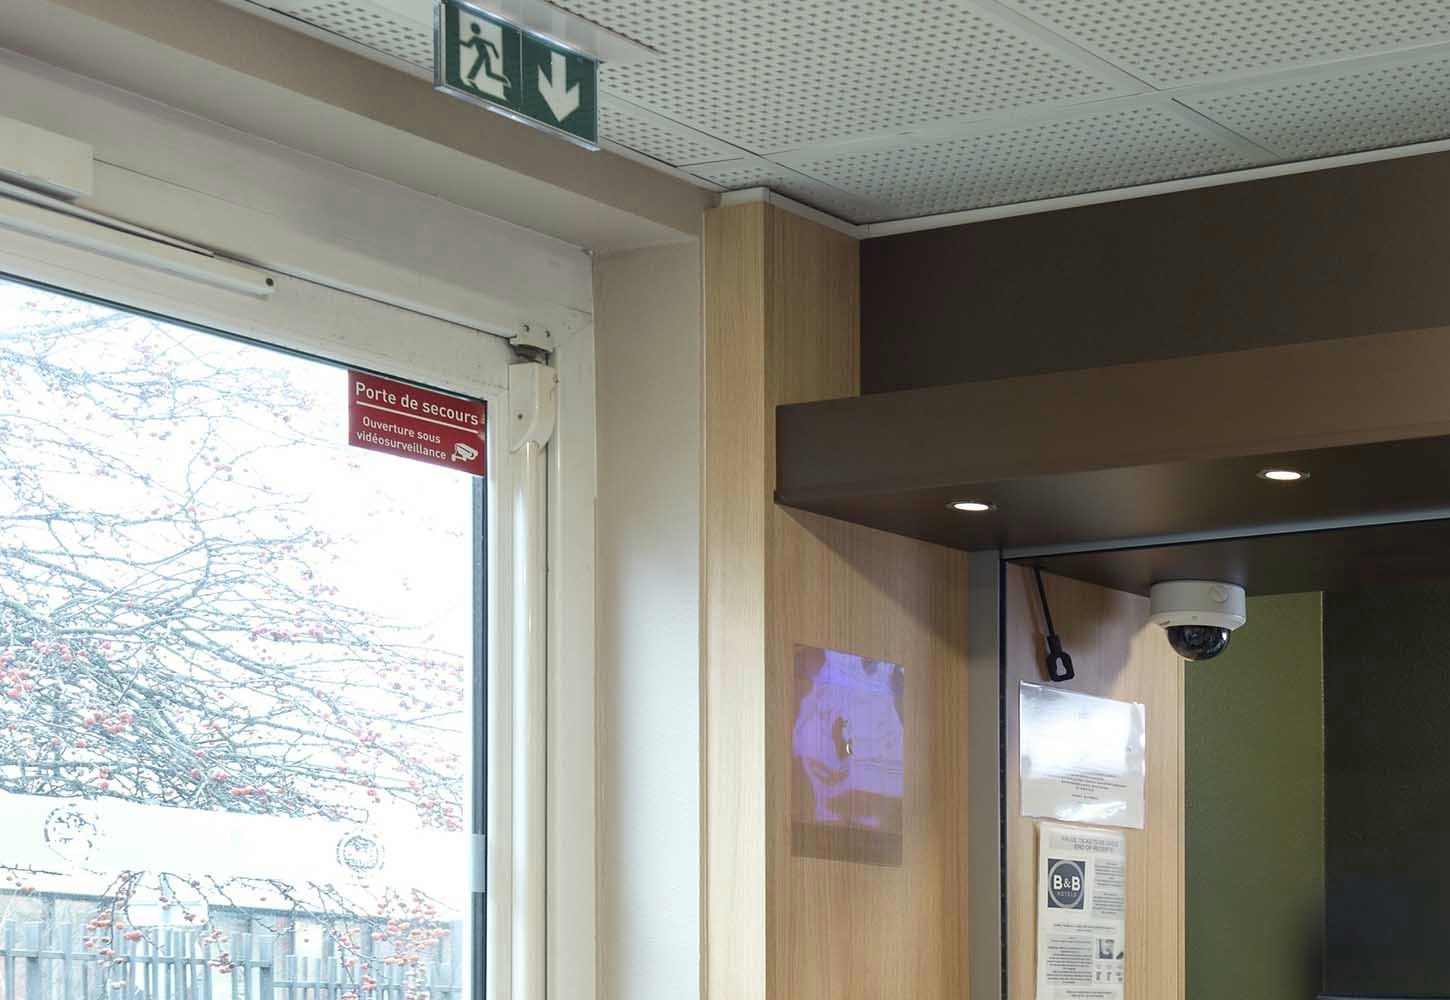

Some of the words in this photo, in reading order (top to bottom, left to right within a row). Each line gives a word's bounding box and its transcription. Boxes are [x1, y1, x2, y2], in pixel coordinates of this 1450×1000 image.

[355, 381, 397, 405] Porte
[400, 394, 419, 410] de
[422, 404, 479, 426] secours
[356, 430, 447, 460] vidéosurveillance
[362, 416, 415, 438] Ouverture
[417, 431, 441, 444] sous
